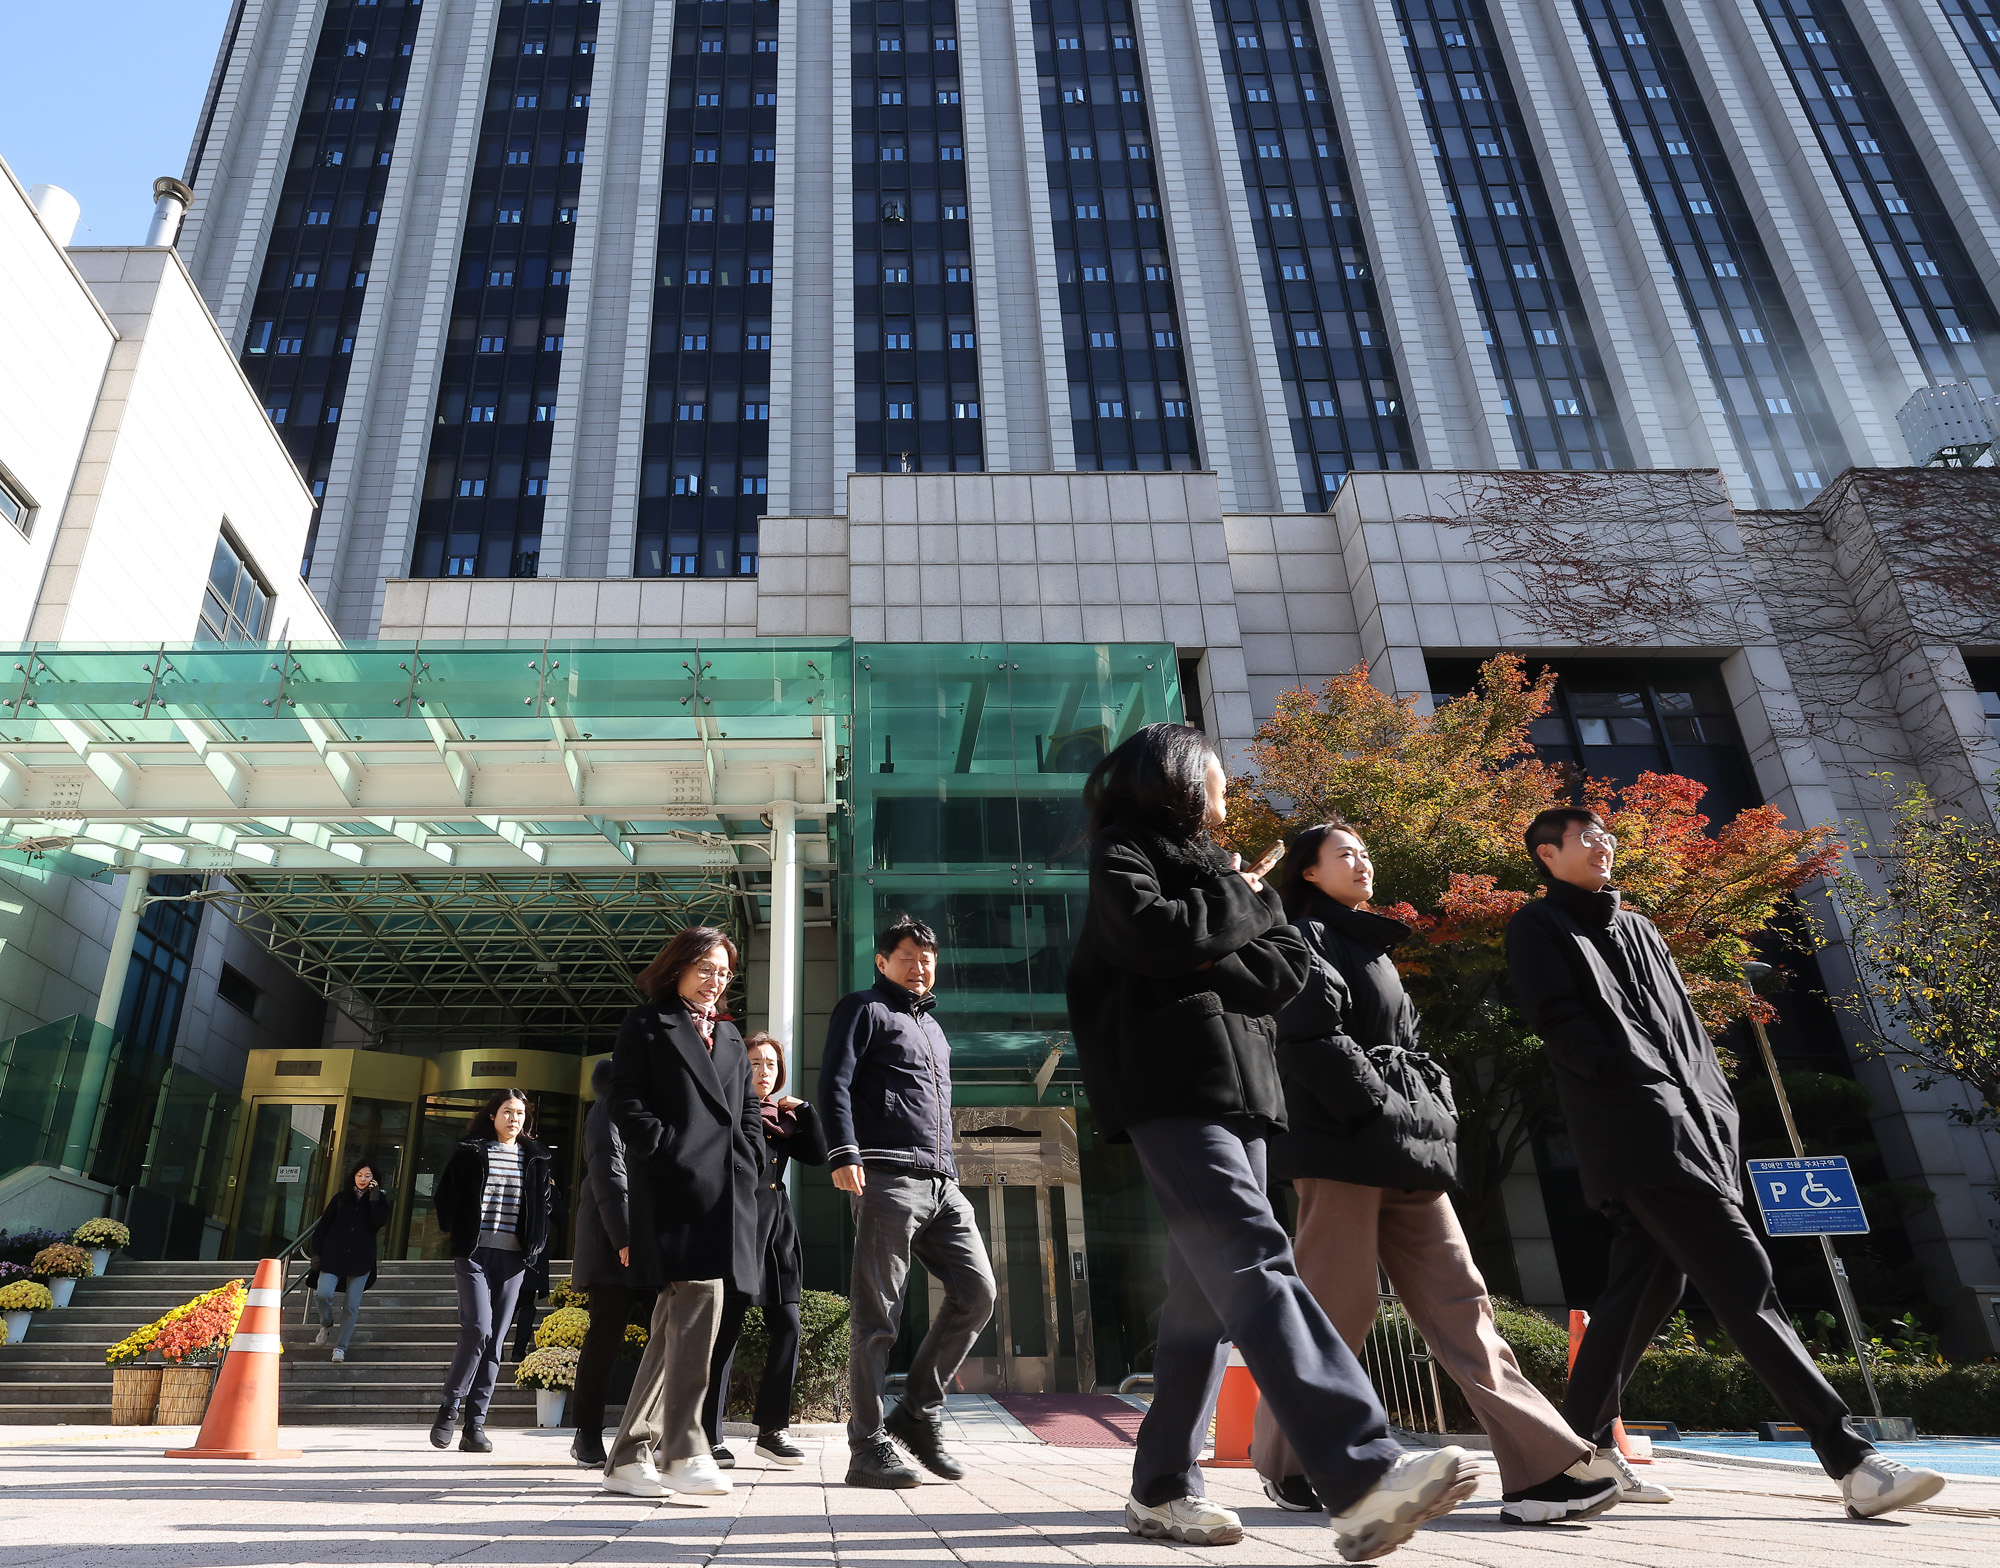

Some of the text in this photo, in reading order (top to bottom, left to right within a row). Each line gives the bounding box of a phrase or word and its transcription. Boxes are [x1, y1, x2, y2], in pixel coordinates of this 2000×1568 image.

[1760, 1159, 1836, 1170] 장애인 전용 주차구역
[1769, 1181, 1787, 1203] P
